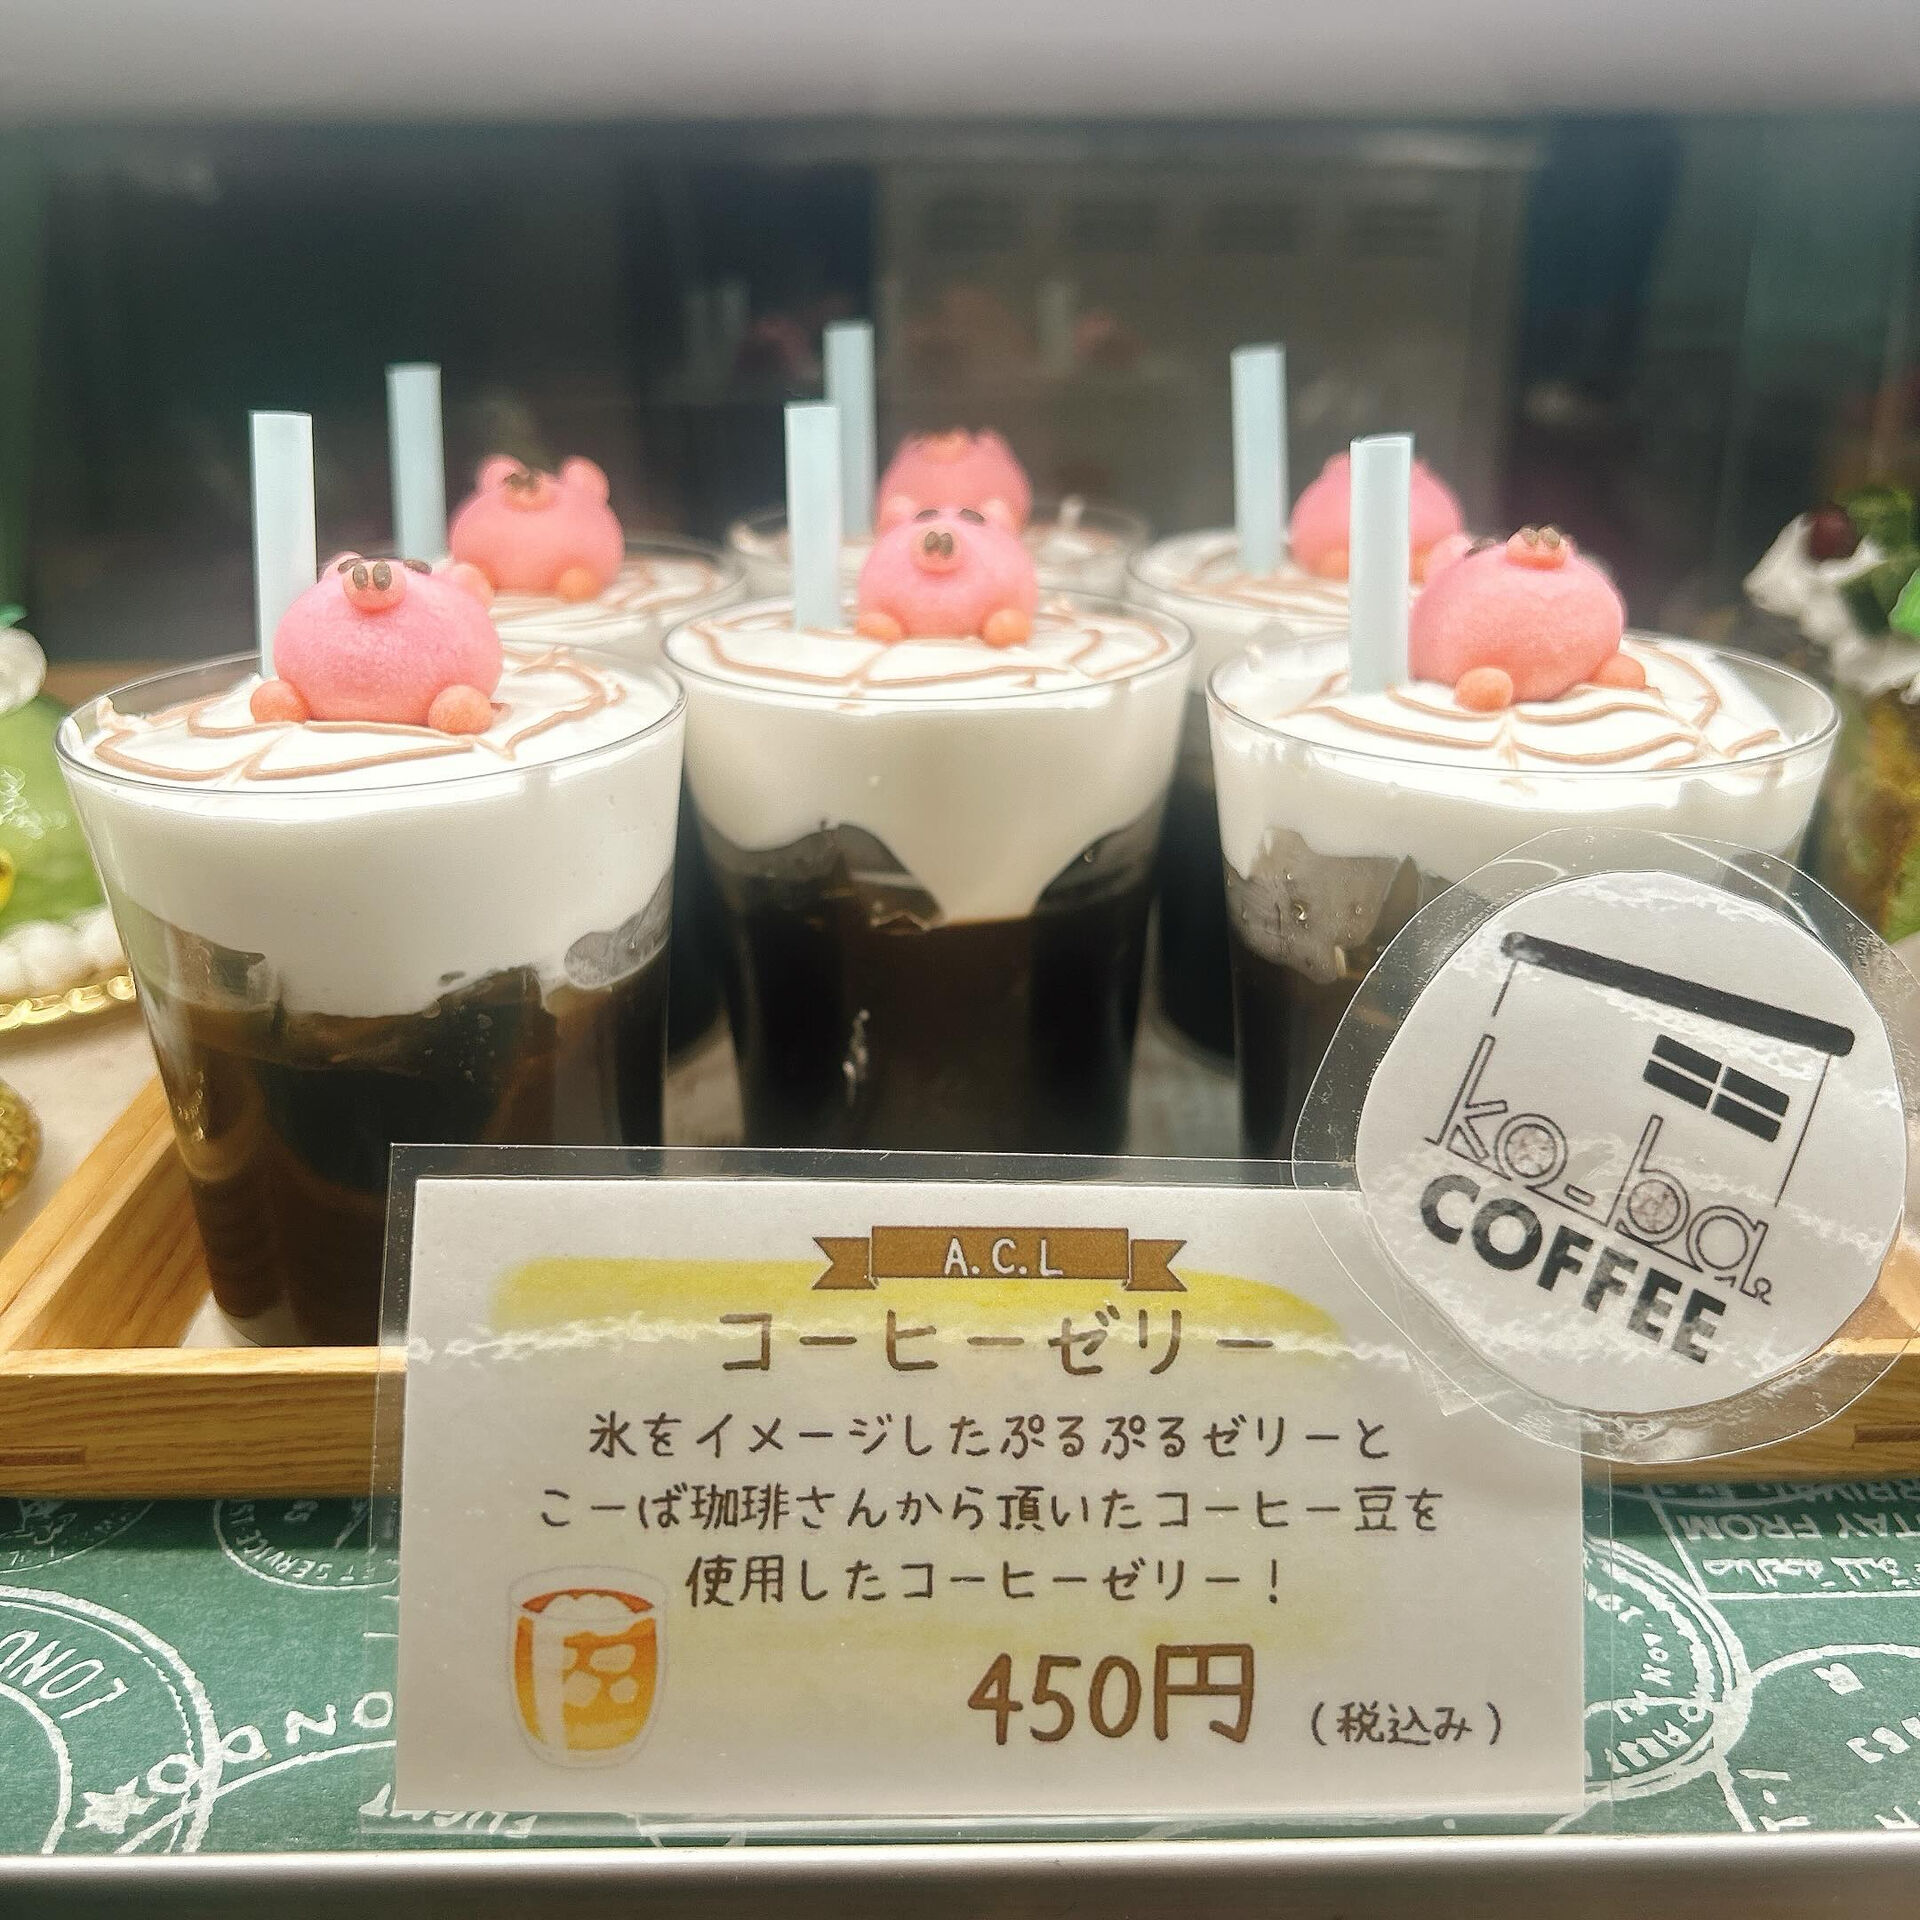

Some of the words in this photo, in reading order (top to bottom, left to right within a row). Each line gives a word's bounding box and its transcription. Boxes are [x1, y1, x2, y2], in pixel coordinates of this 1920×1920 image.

[943, 1237, 1064, 1277] A.C.L
[1421, 1174, 1727, 1364] COFFEE
[719, 1304, 1275, 1377] コーヒーゼリー
[588, 1410, 1391, 1461] 氷をイメージしたぷるぷるゼリーと
[540, 1481, 1444, 1532] こーば珈琲さんから頂いたコーヒー豆を
[967, 1643, 1255, 1746] 450円
